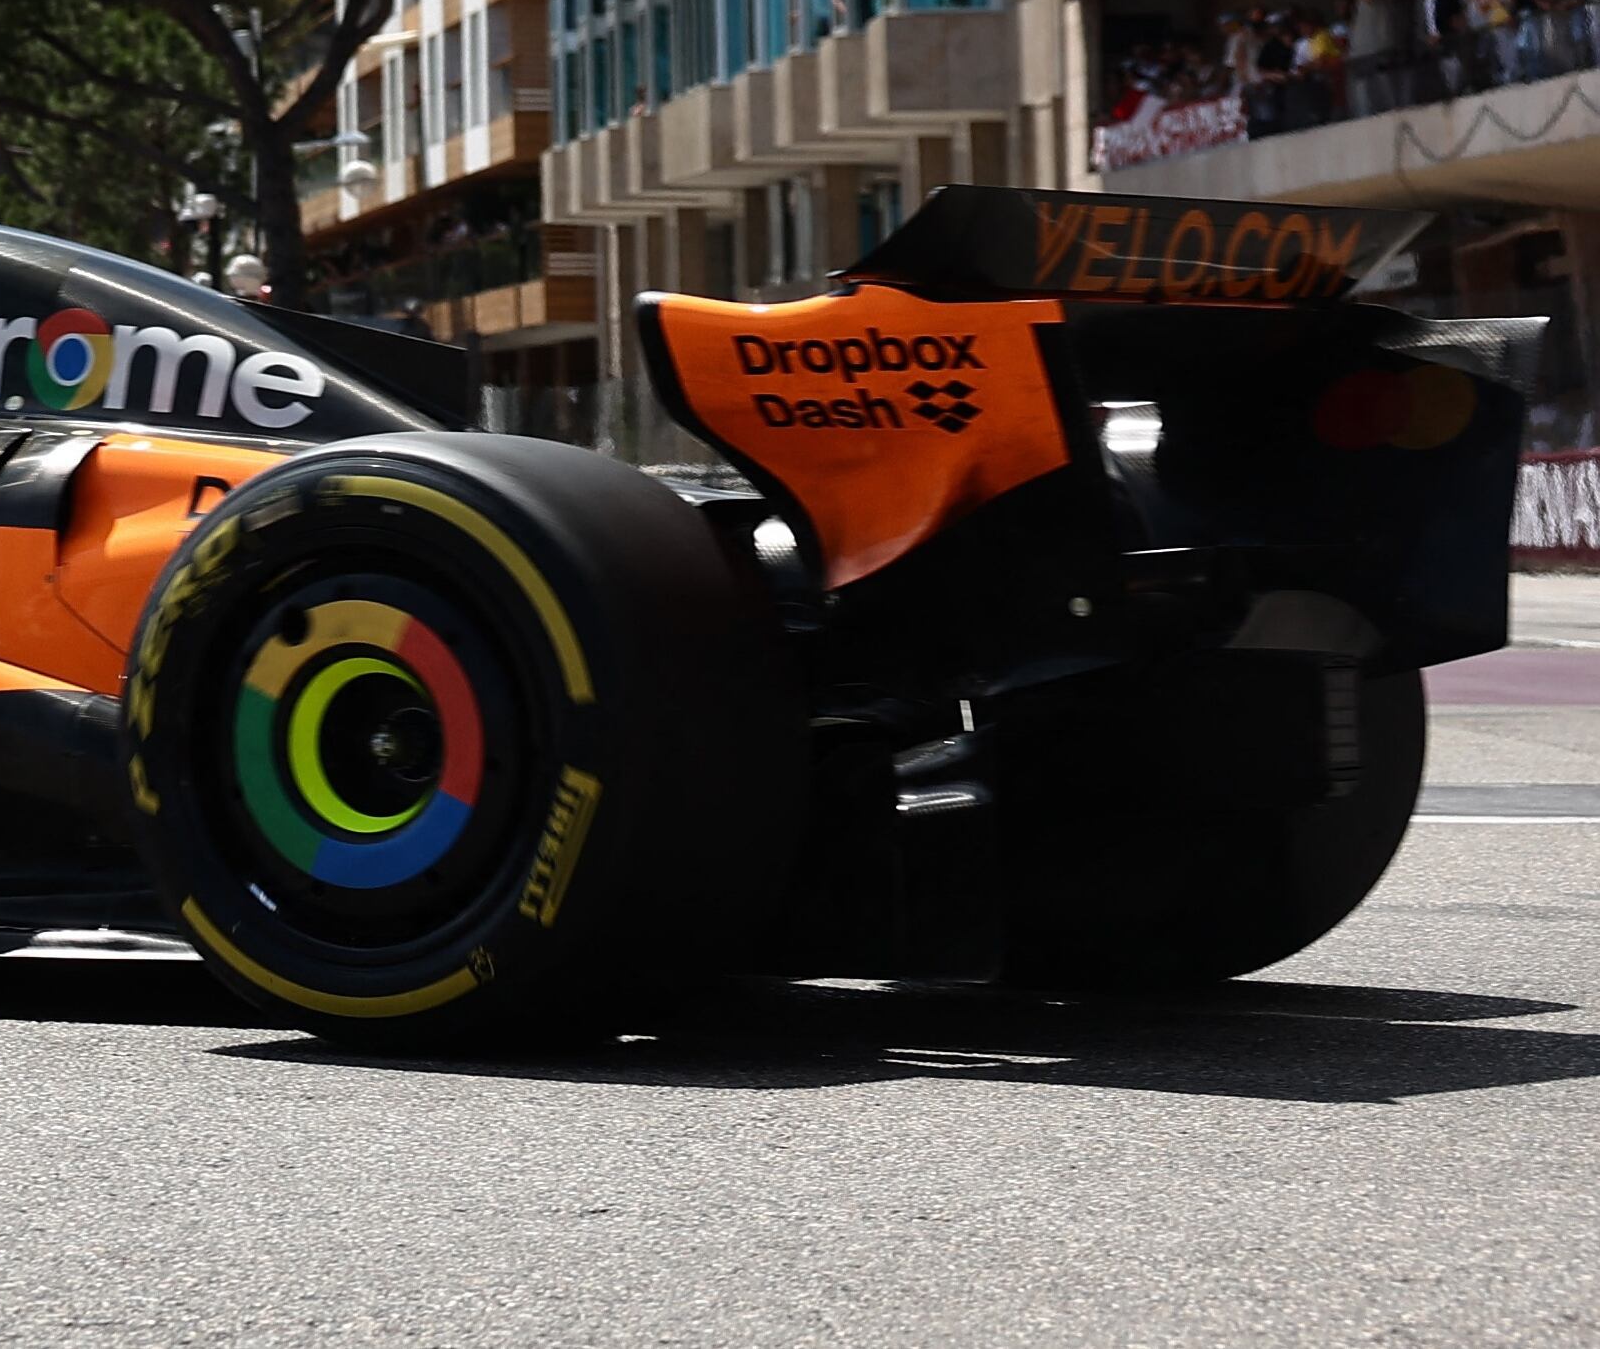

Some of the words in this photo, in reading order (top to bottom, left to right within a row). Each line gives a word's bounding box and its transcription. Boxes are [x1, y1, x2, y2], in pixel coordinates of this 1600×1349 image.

[1033, 201, 1363, 300] VELO.COM
[731, 327, 988, 383] Dropbox
[752, 388, 905, 429] Dash
